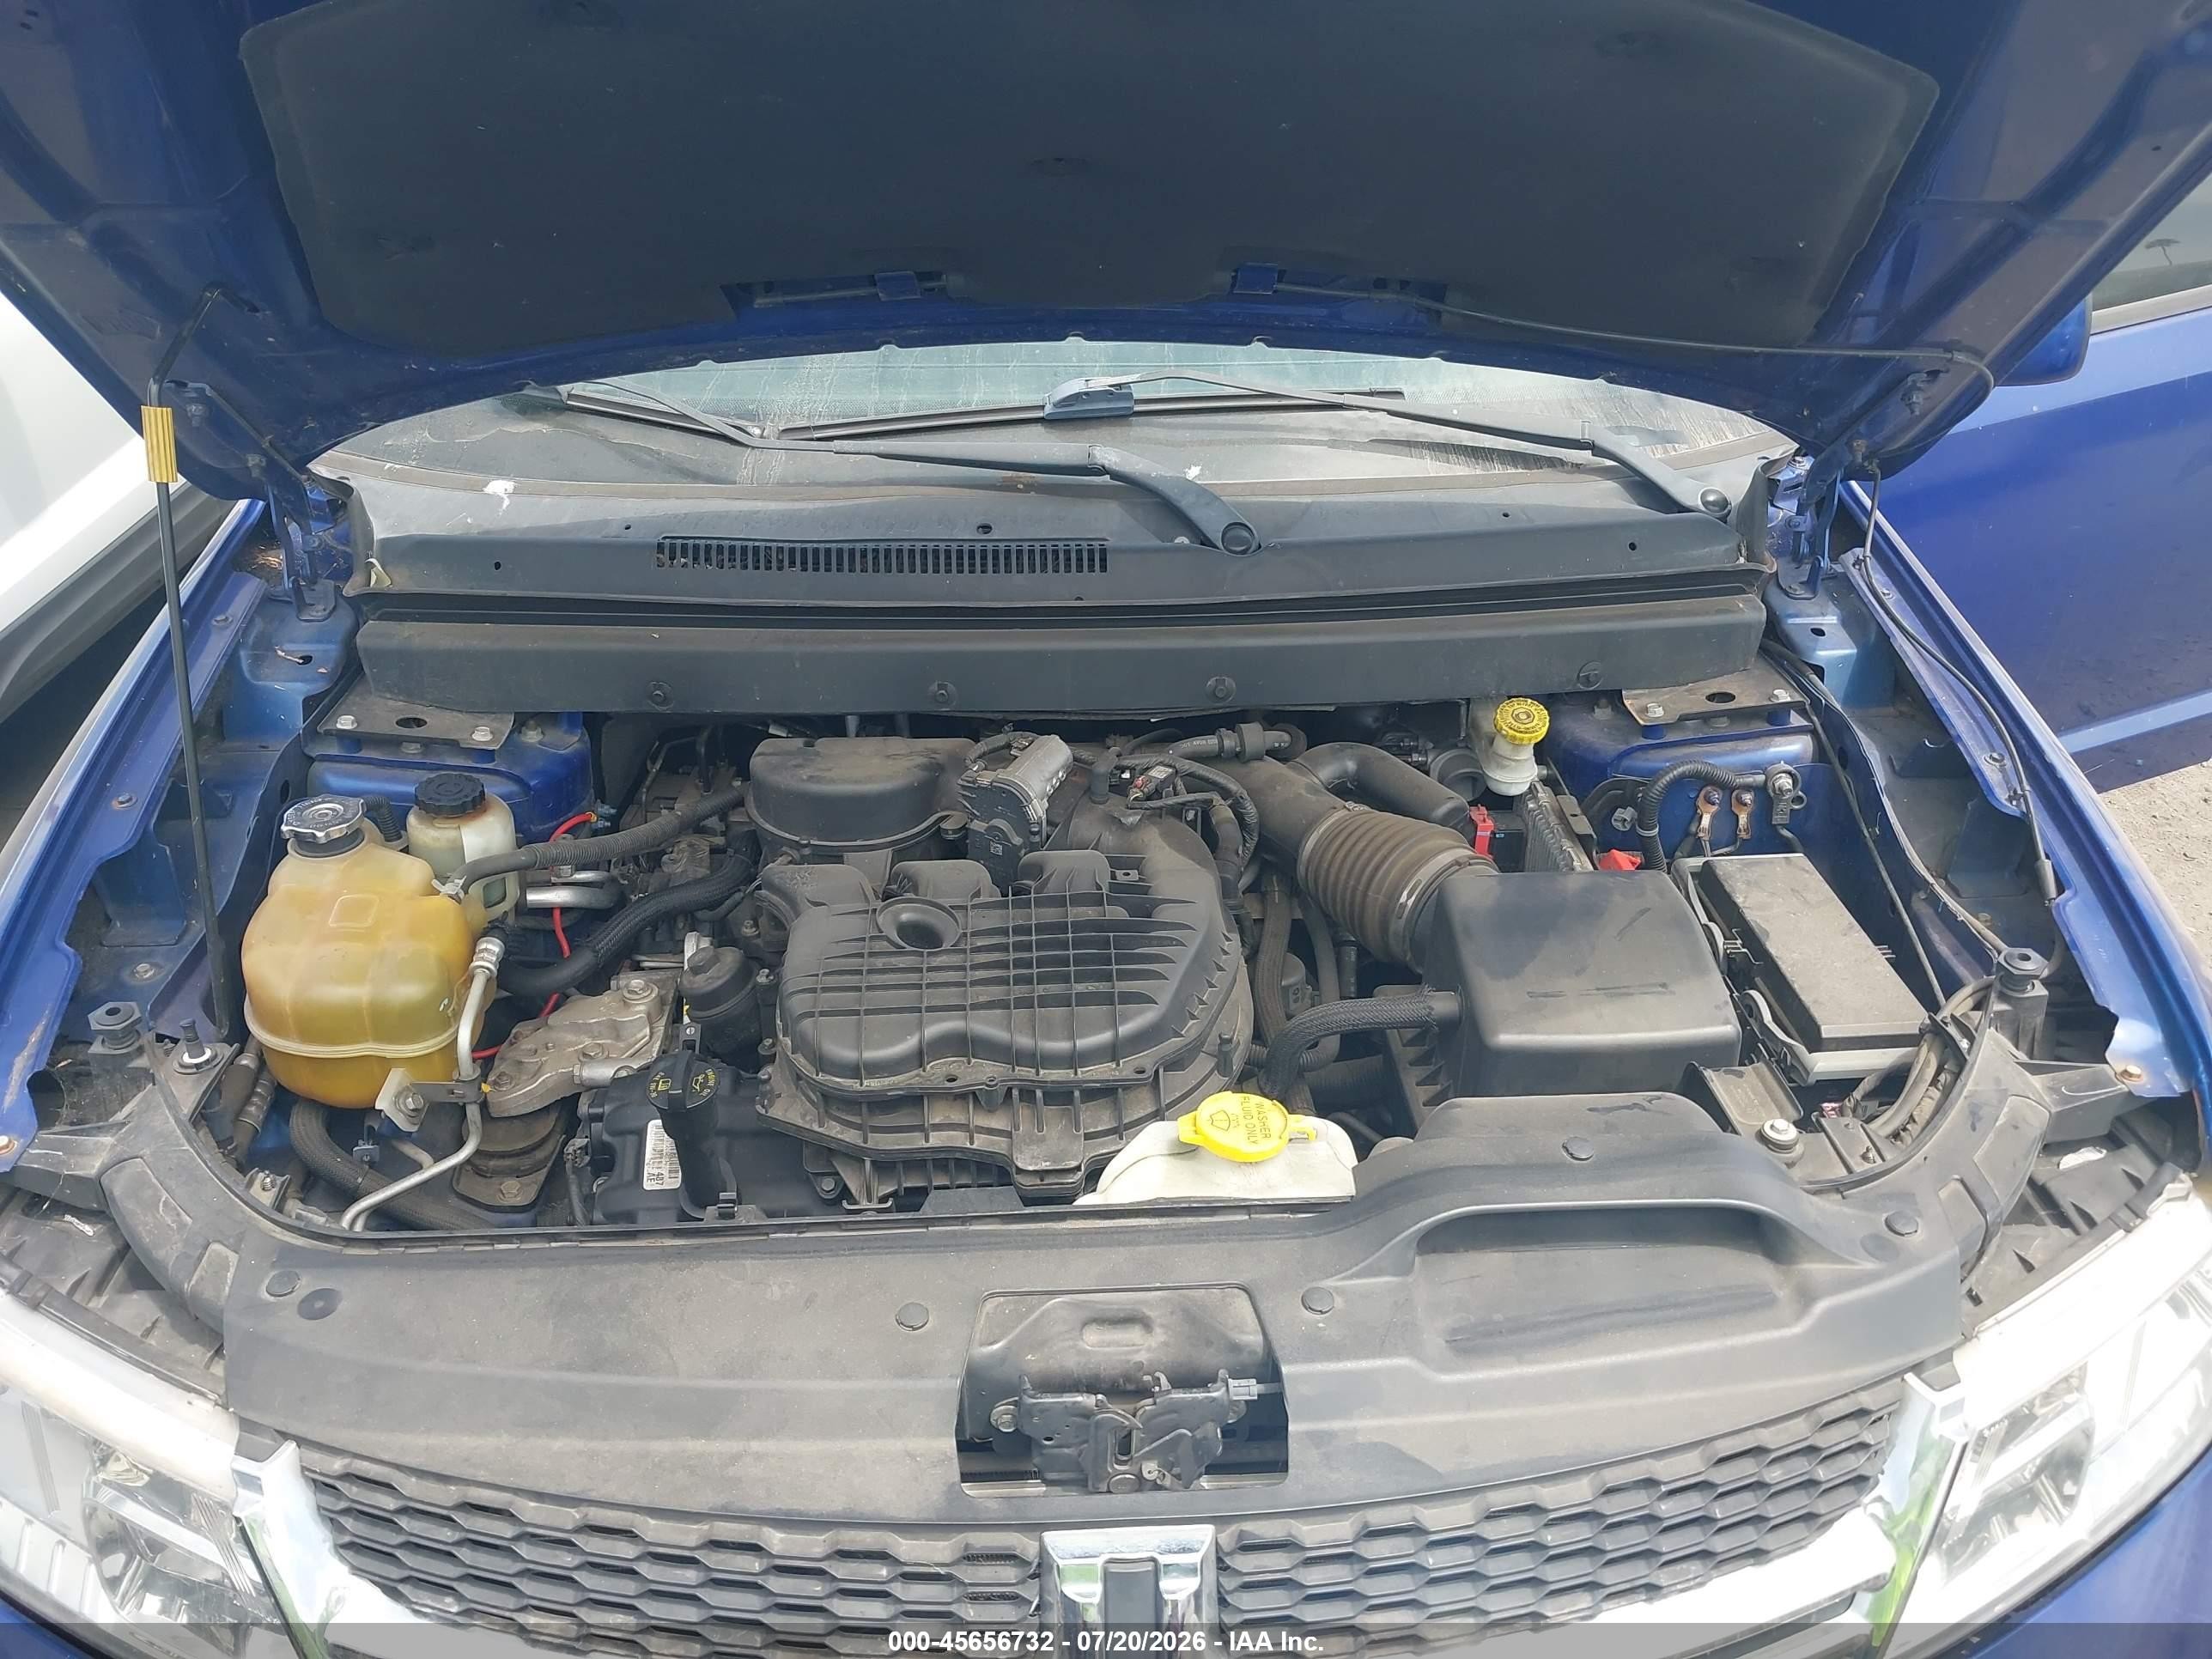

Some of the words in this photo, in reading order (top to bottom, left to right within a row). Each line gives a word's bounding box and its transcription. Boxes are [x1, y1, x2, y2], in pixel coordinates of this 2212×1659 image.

[1240, 1096, 1254, 1121] FLUID
[1255, 1102, 1272, 1139] WASHER
[1244, 1122, 1260, 1145] ONLY
